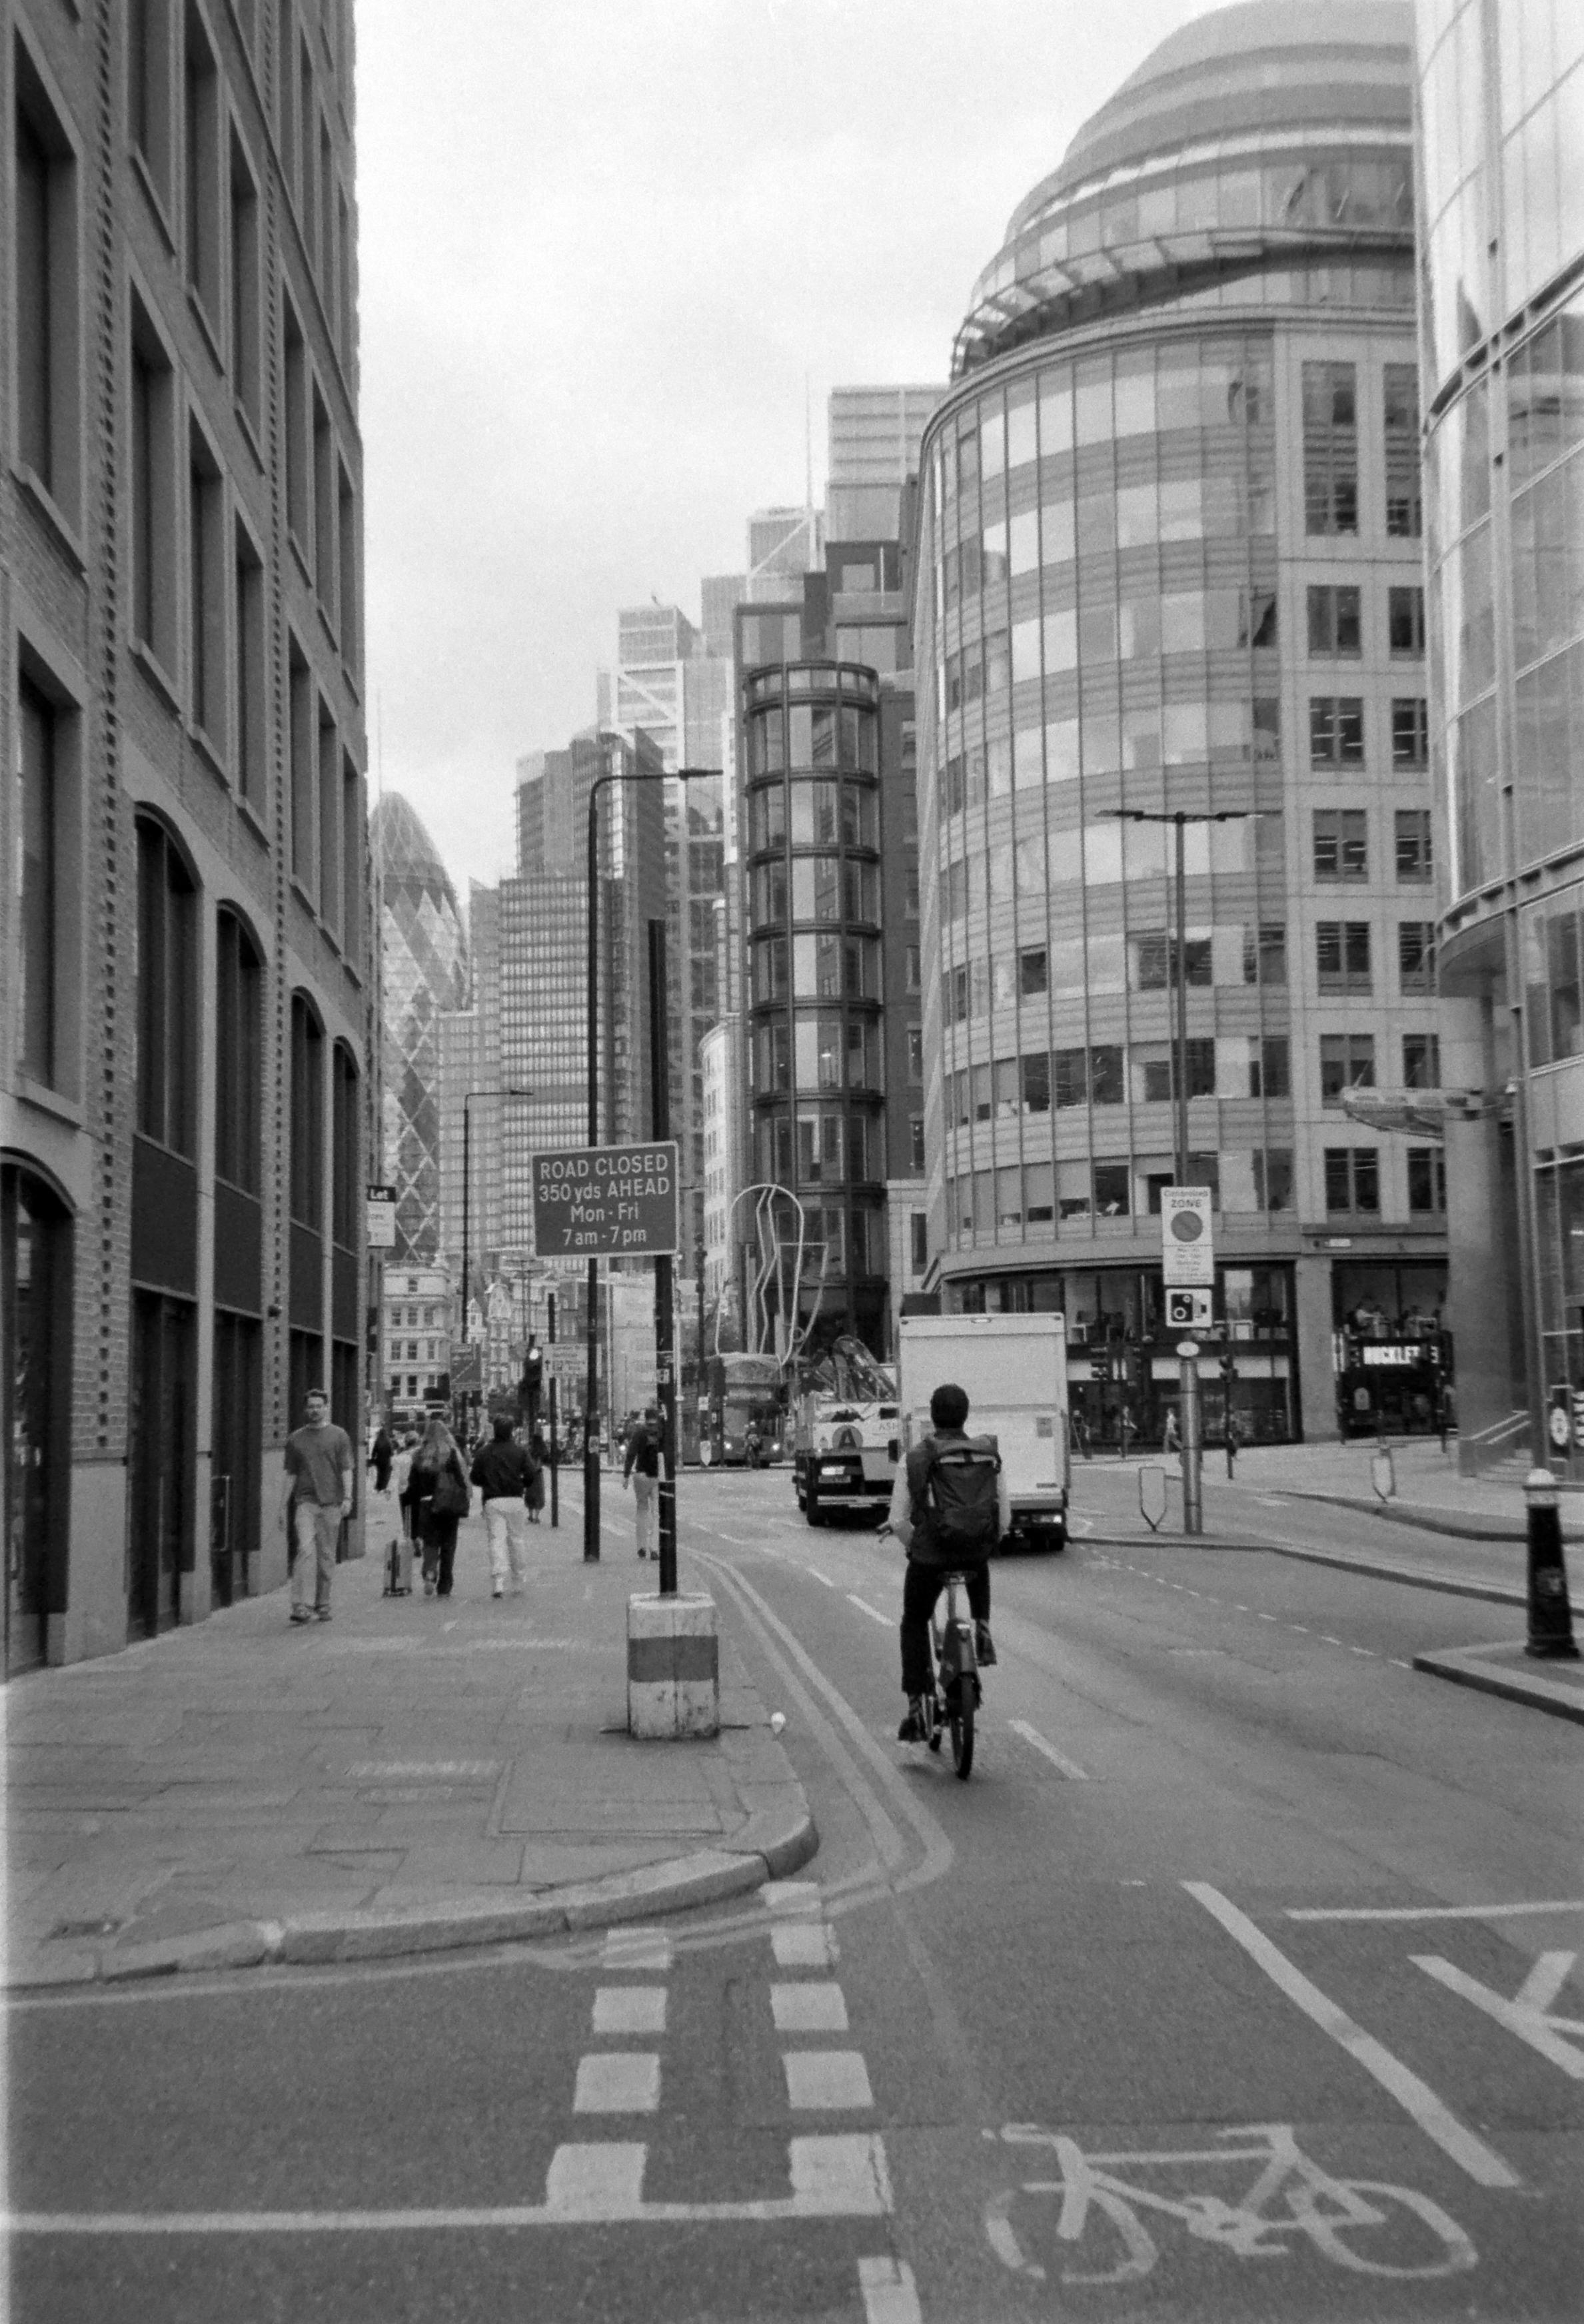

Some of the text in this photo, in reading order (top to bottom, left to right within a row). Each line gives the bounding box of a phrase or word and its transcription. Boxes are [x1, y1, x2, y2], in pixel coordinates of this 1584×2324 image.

[540, 1153, 668, 1179] ROAD CLOSED
[371, 1189, 388, 1199] Let
[607, 1177, 670, 1197] AHEAD
[570, 1205, 605, 1223] Mon
[618, 1202, 639, 1221] Fri
[1171, 1199, 1202, 1208] ZONE
[838, 1428, 857, 1449] A
